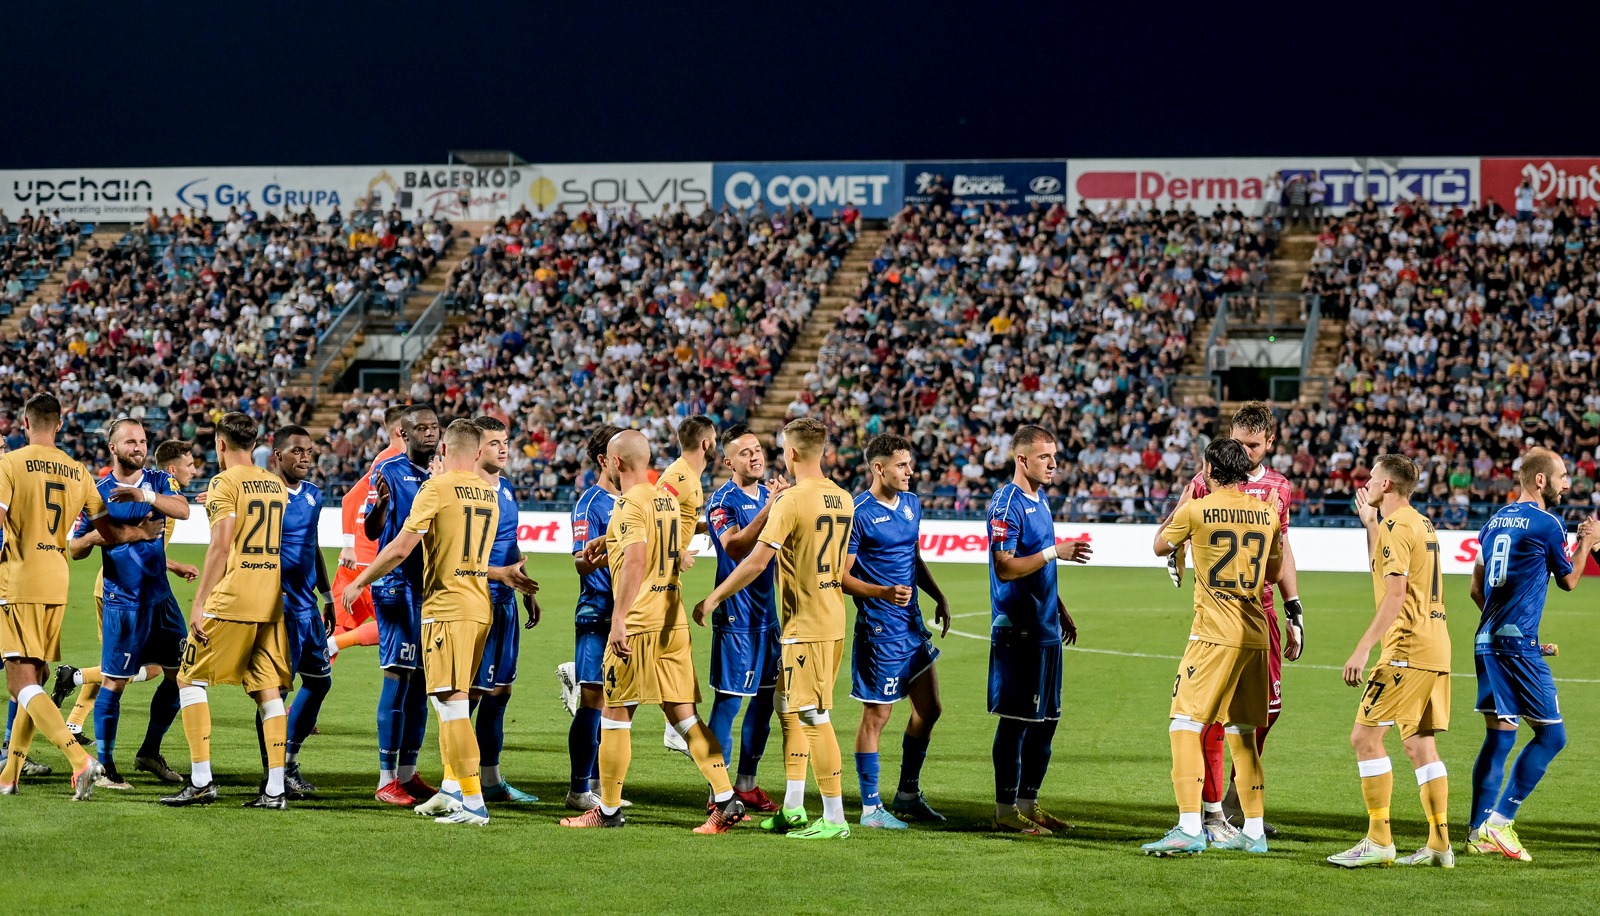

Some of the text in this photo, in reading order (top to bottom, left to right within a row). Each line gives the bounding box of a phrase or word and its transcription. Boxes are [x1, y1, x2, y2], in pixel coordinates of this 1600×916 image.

[14, 176, 153, 206] upchain
[404, 169, 521, 188] BAGERKOP
[560, 178, 706, 204] SOLVIS
[766, 175, 889, 206] COMET
[1140, 171, 1262, 199] Derma
[1324, 170, 1466, 203] TOKIĆ
[262, 183, 341, 207] GRUPA
[25, 459, 81, 481] BOREVKOVIĆ
[45, 482, 66, 536] 5
[823, 494, 843, 509] BIUK
[242, 500, 284, 556] 20
[1203, 508, 1271, 526] KROVINOVIĆ
[463, 506, 492, 563] 17
[656, 518, 681, 577] 14
[816, 515, 851, 575] 27
[1209, 530, 1266, 588] 23
[1489, 534, 1512, 587] 8
[124, 652, 131, 670] 7
[400, 642, 416, 661] 20
[487, 665, 495, 682] 5
[744, 670, 755, 689] 17
[884, 676, 899, 696] 22
[1033, 694, 1041, 713] 4
[1361, 679, 1386, 706] 77
